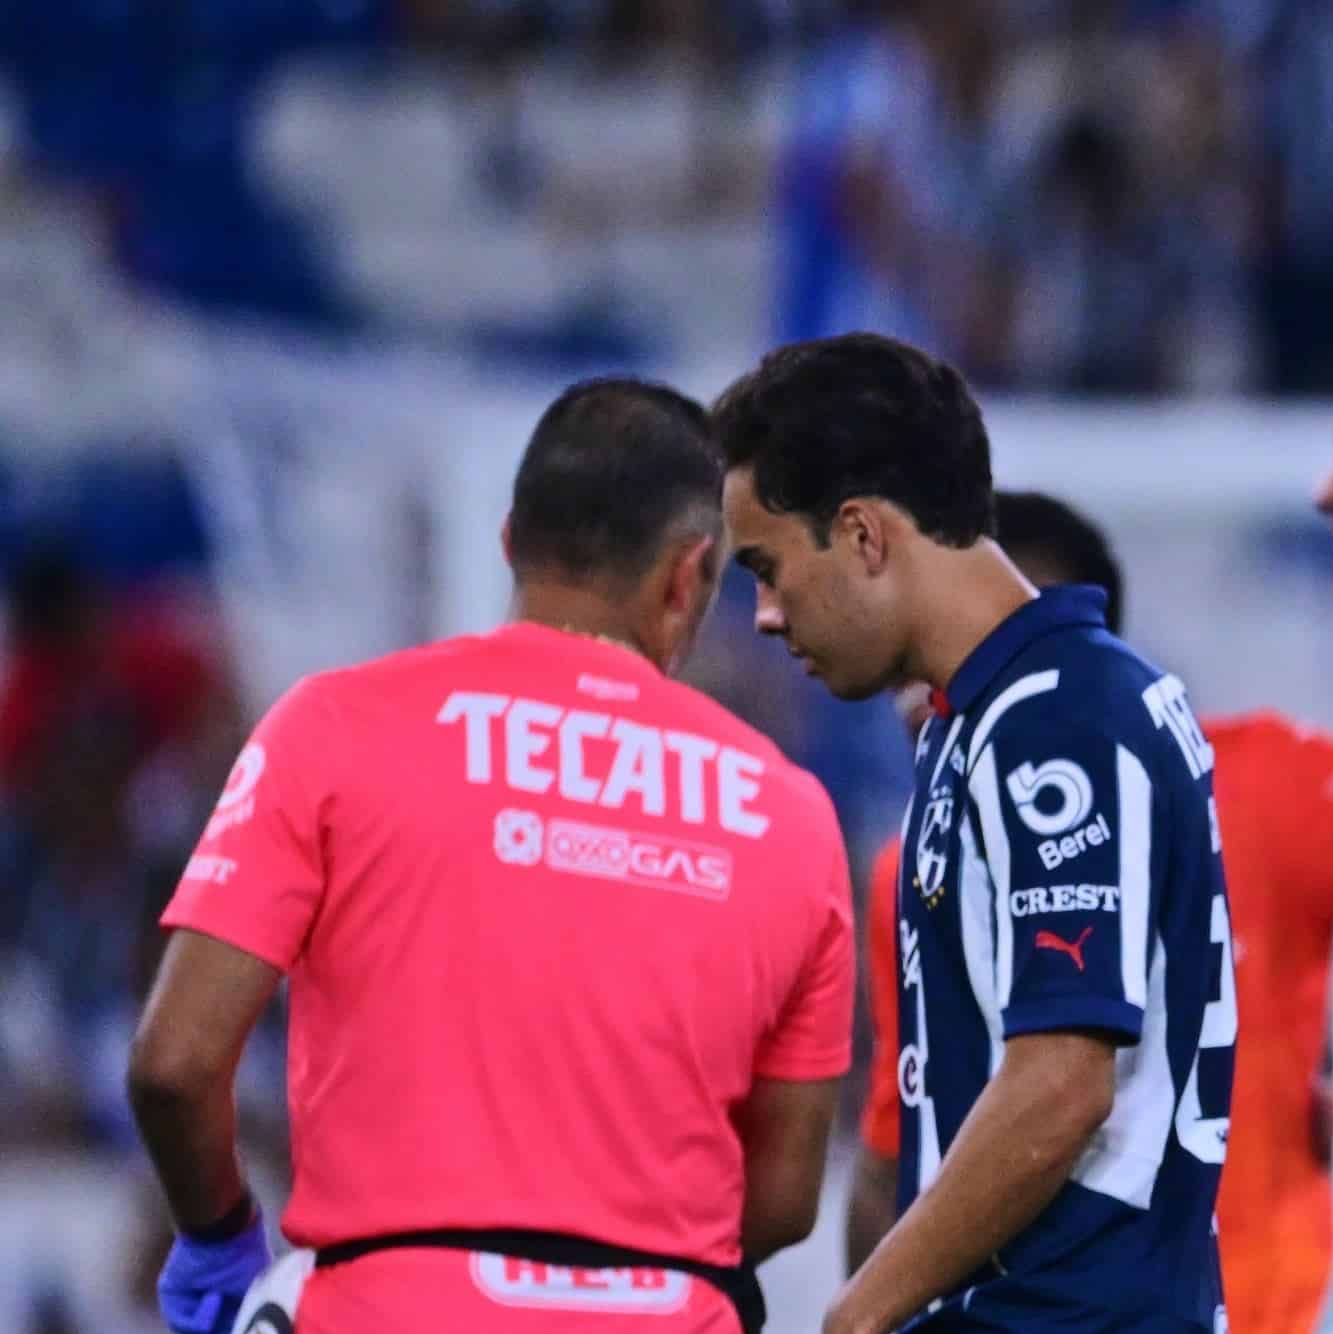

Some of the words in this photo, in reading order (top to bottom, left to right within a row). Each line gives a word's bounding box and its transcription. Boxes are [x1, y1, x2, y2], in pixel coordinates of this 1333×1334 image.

[435, 690, 771, 839] TECATE
[1037, 812, 1111, 871] Berel
[1010, 883, 1120, 917] CREST
